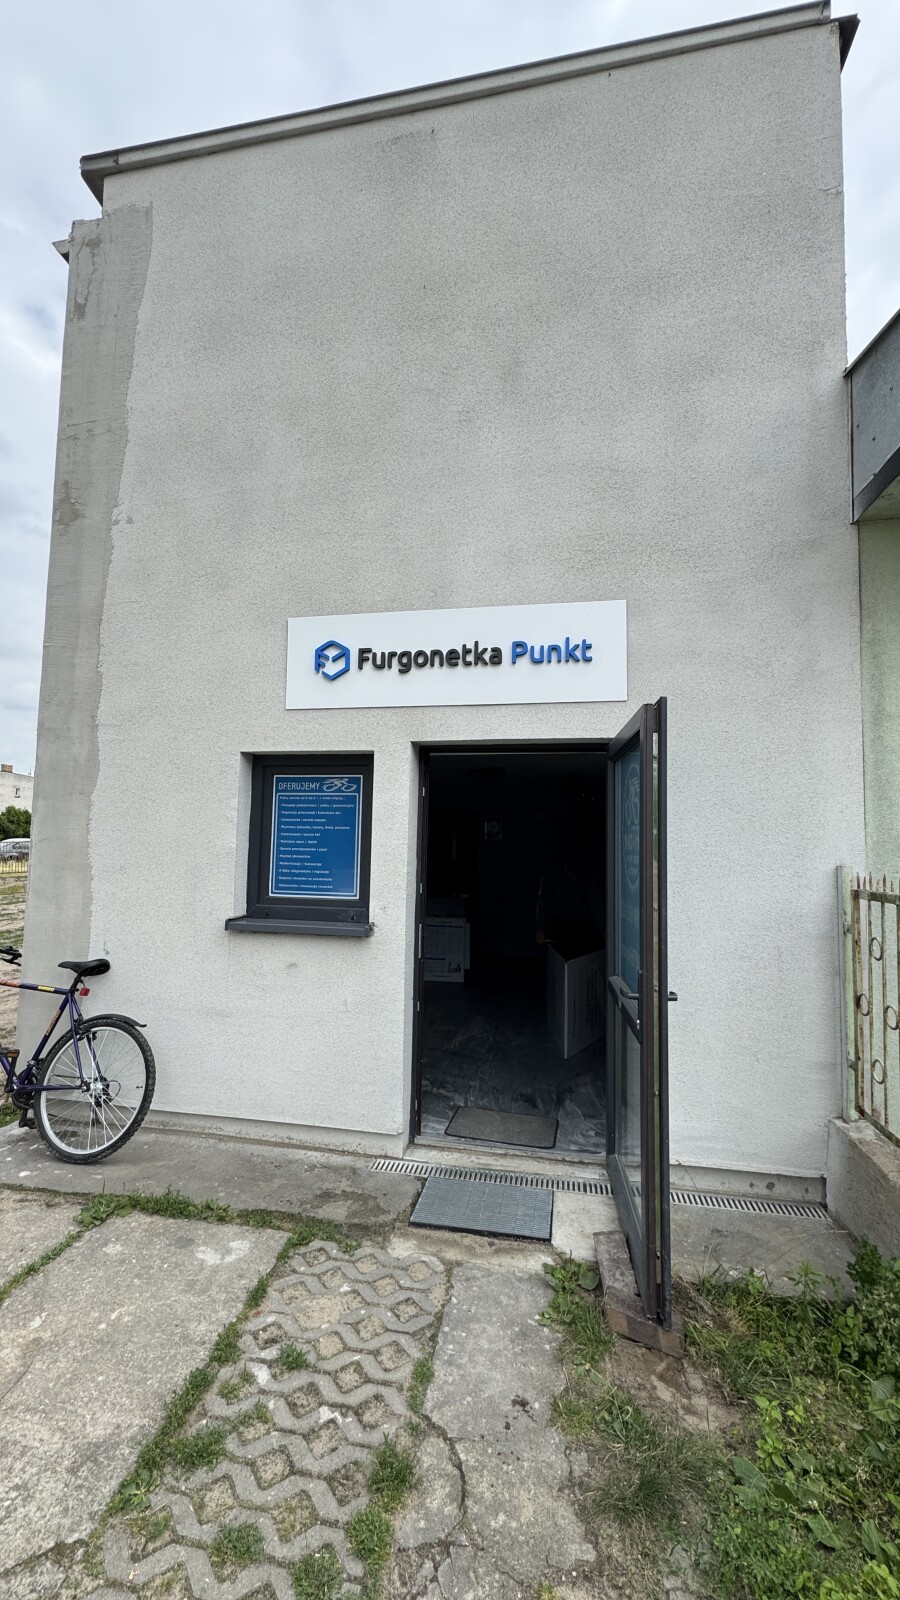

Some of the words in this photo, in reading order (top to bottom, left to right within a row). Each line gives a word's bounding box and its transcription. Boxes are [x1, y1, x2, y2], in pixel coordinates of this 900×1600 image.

[358, 641, 502, 674] Furgonetka
[511, 636, 593, 665] Punkt
[278, 782, 320, 791] OFERUJEMY
